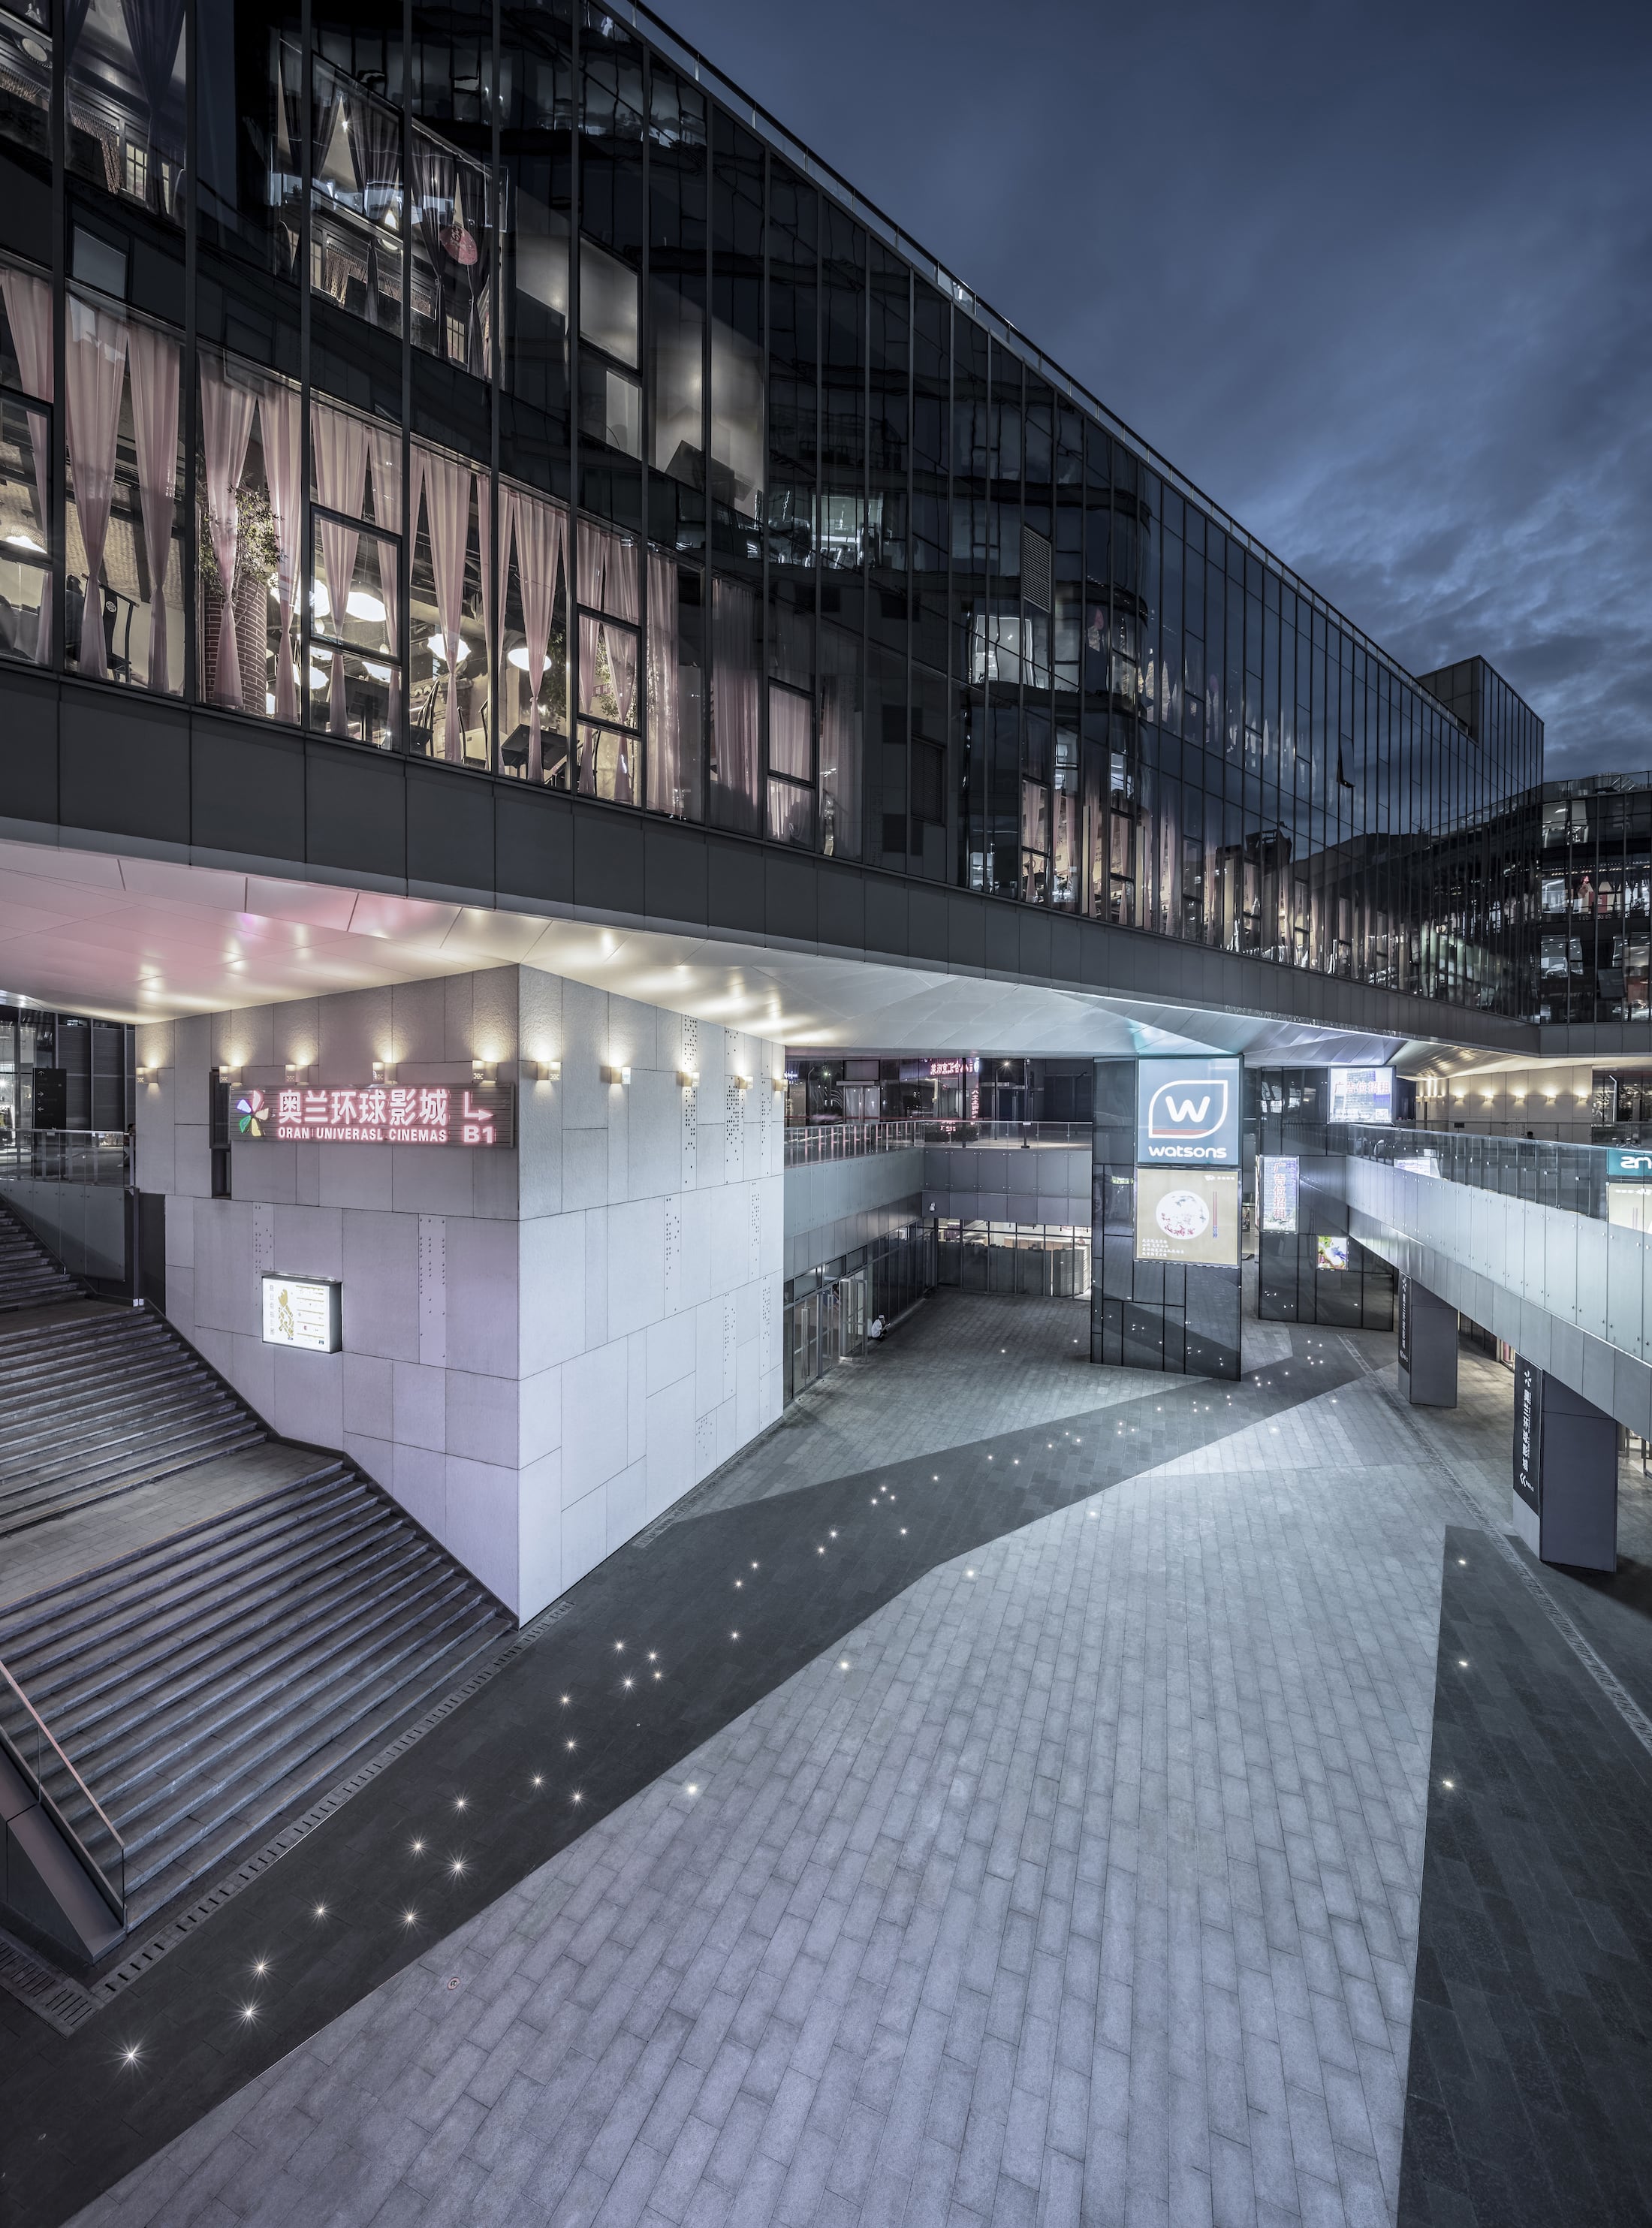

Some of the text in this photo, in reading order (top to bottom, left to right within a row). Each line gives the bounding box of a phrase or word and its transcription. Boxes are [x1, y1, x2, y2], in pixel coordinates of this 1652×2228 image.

[1334, 1081, 1391, 1094] 广告位招租
[279, 1089, 447, 1126] 奥兰环球影城
[279, 1127, 447, 1141] ORAN UNIVERASL CINEMAS
[464, 1126, 493, 1143] B1
[1148, 1146, 1227, 1158] watsons
[1274, 1162, 1286, 1219] 广告位招租
